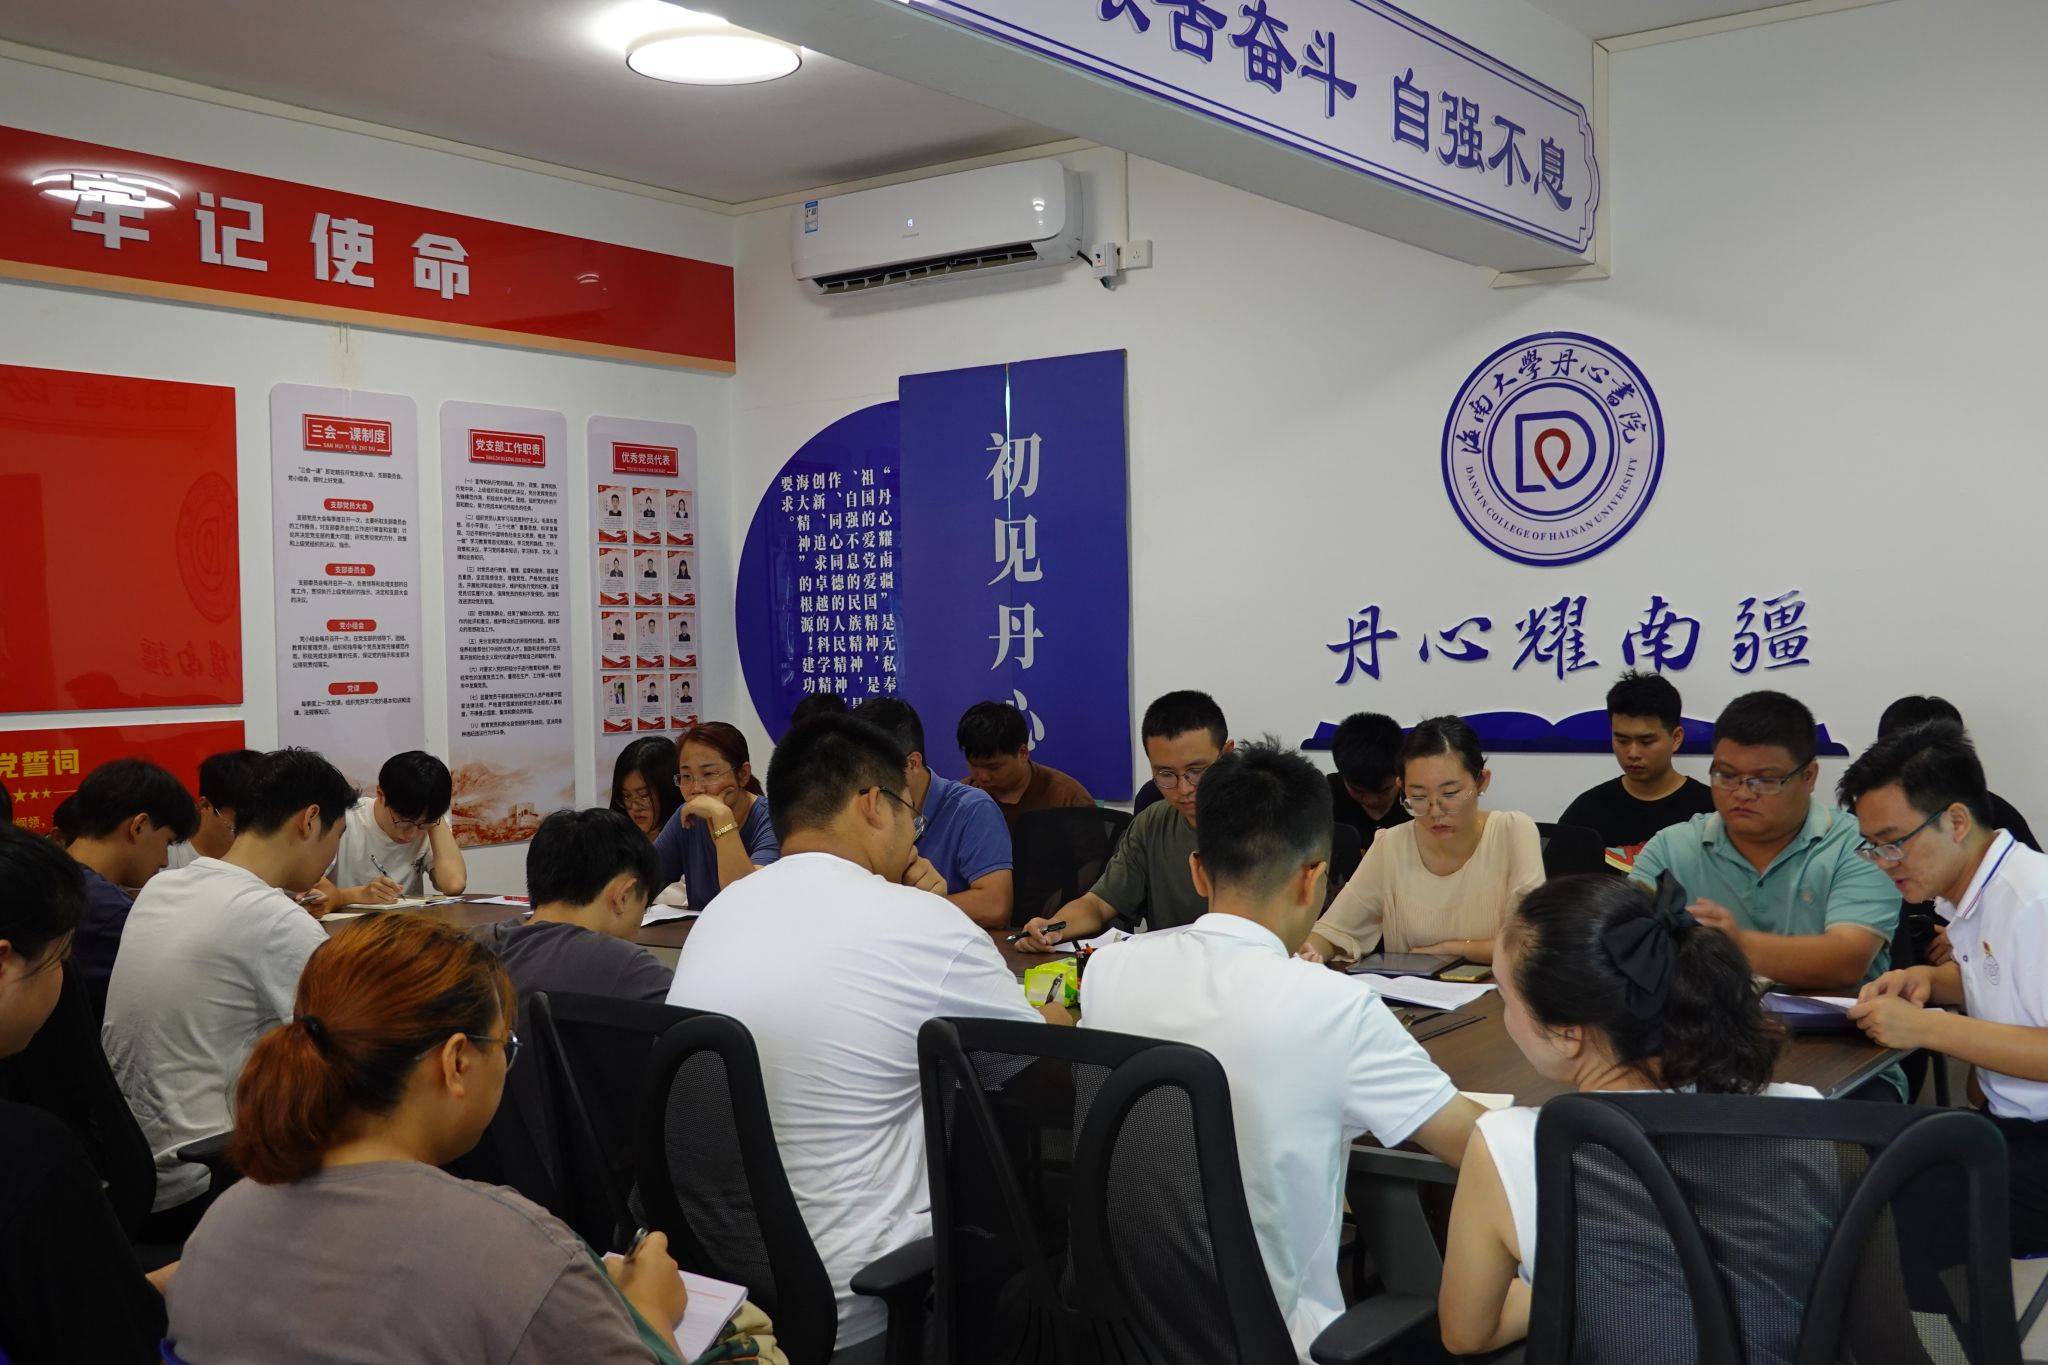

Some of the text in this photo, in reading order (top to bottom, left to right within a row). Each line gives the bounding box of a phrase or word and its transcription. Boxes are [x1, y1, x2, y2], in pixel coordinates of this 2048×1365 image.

[1097, 0, 1573, 212] 苦奋斗 自强不息
[69, 171, 472, 300] 牢记使命
[311, 423, 386, 444] 三会一课制度
[475, 438, 541, 456] 党支部工作职责
[621, 451, 671, 466] 优秀党员代表
[330, 501, 368, 511] 支部党员大会
[1466, 457, 1639, 541] DANXIN COLLEGE OF HAINAN UNIVERSITY
[335, 565, 367, 574] 支部委员会
[1325, 590, 1811, 685] 丹心耀南疆
